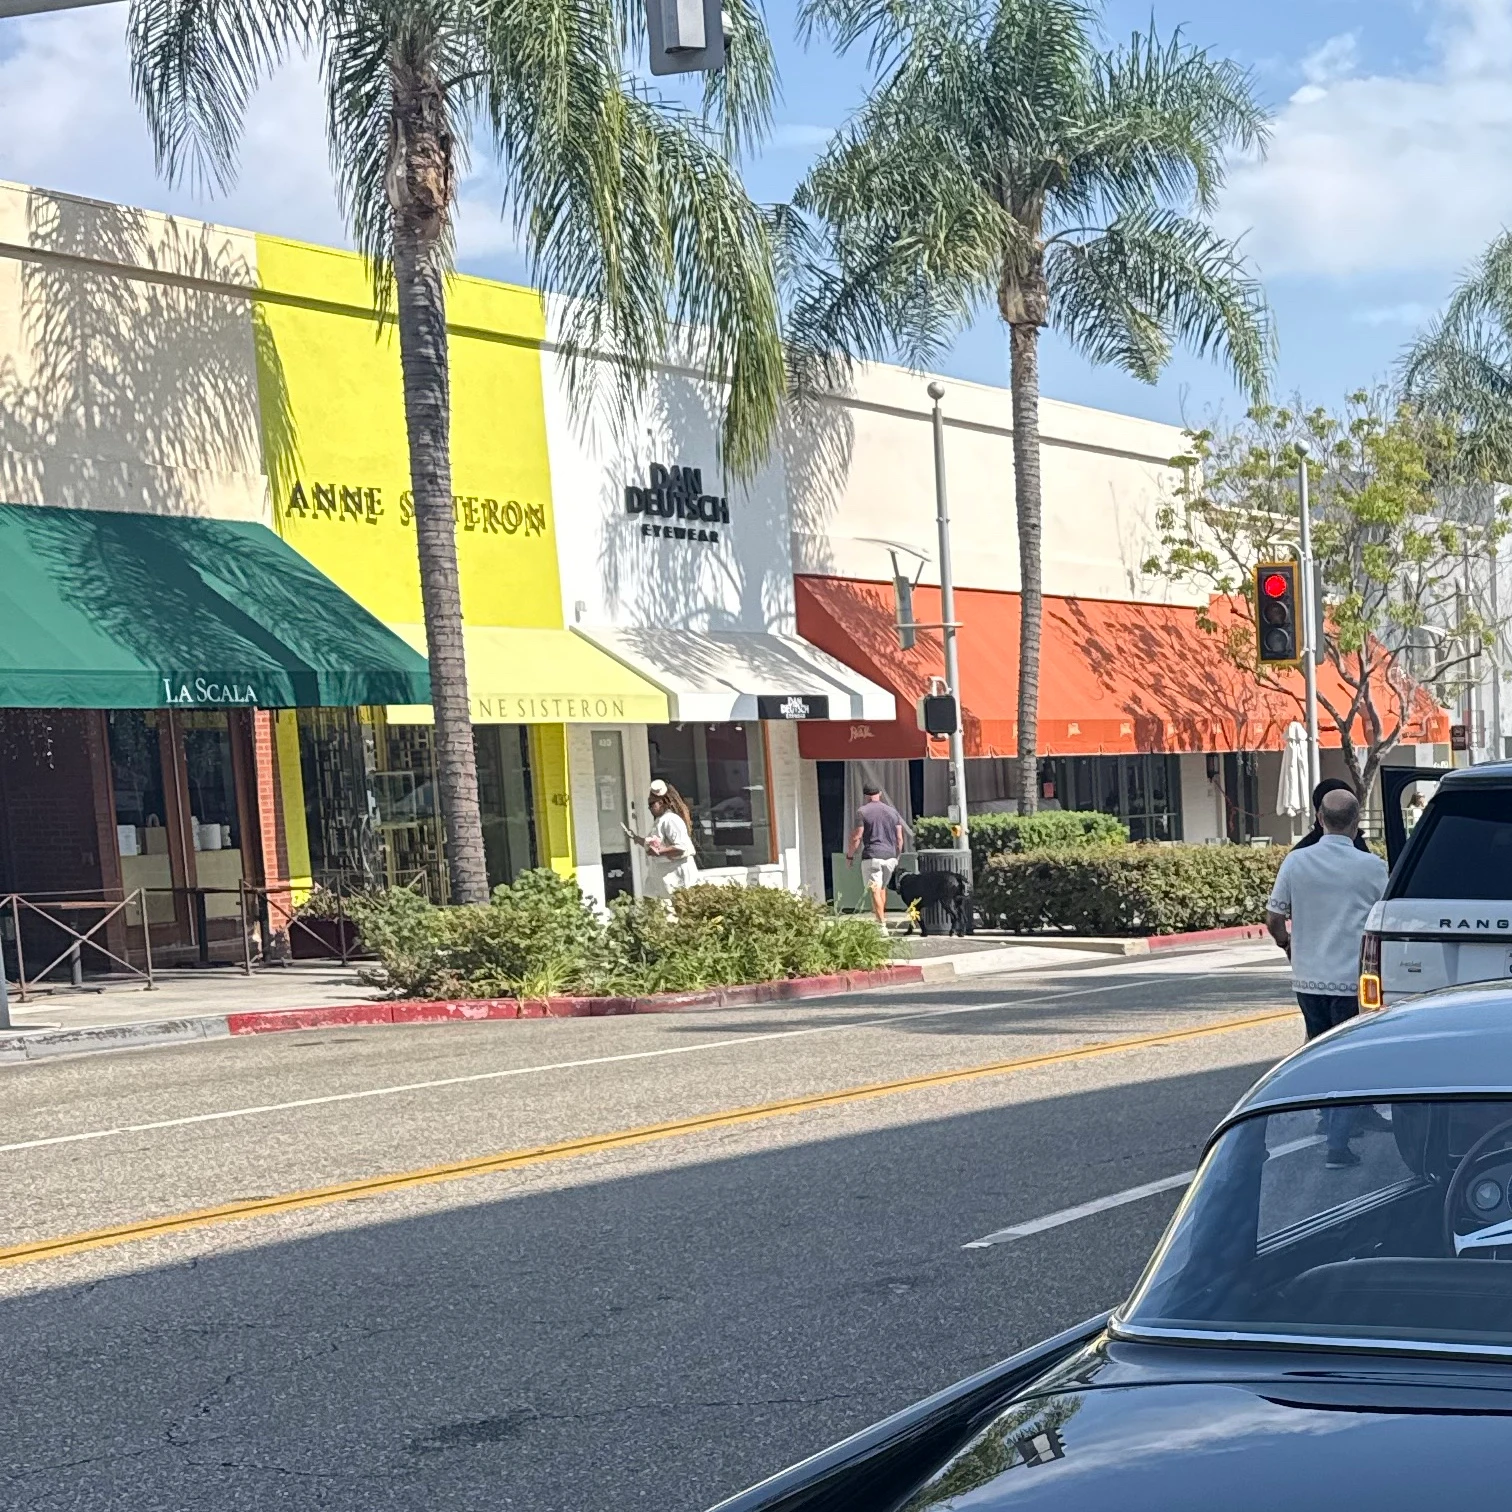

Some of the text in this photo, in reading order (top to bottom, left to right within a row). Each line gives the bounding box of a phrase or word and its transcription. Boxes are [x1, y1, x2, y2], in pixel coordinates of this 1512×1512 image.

[649, 462, 703, 495] DAN
[286, 479, 384, 522] ANNE
[626, 486, 730, 523] DEUTSCH
[641, 524, 719, 543] EYEWEAR
[518, 699, 625, 717] SISTERON
